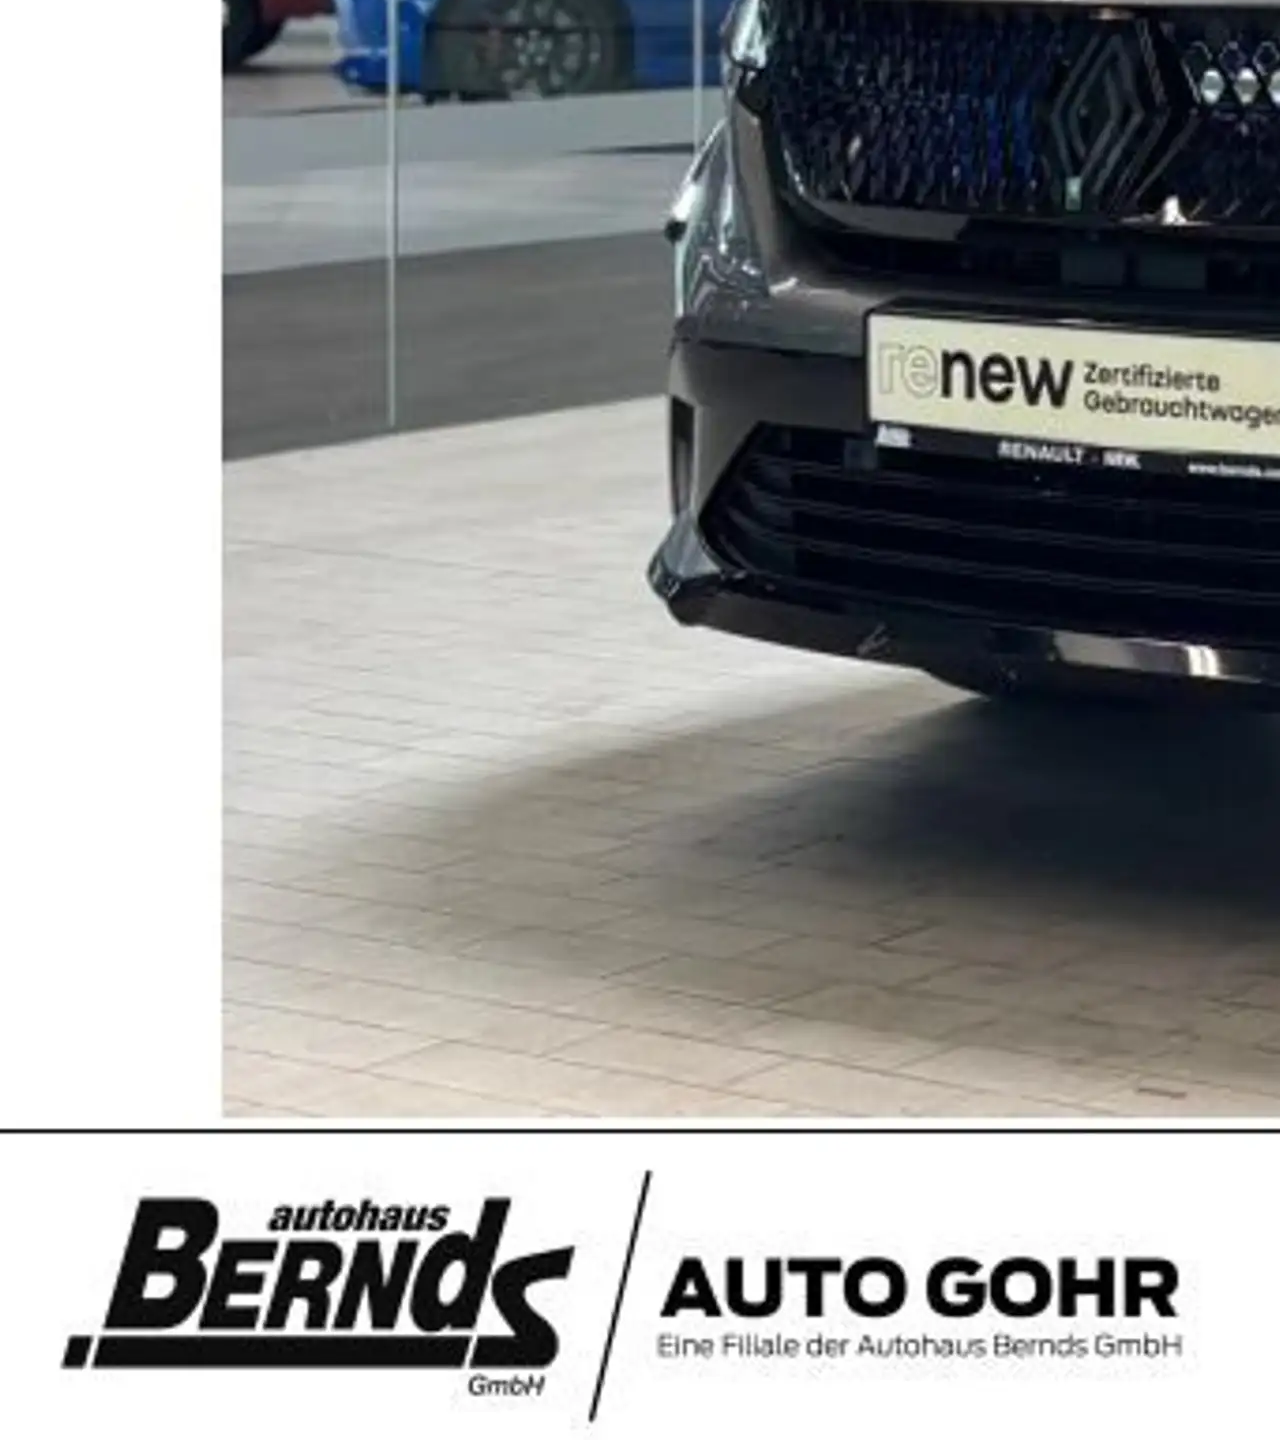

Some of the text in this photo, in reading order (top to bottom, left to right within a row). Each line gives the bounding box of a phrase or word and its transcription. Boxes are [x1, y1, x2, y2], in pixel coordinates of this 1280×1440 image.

[878, 341, 1073, 408] renew
[1083, 361, 1221, 392] Zertifizierte
[998, 440, 1084, 465] RENAULT
